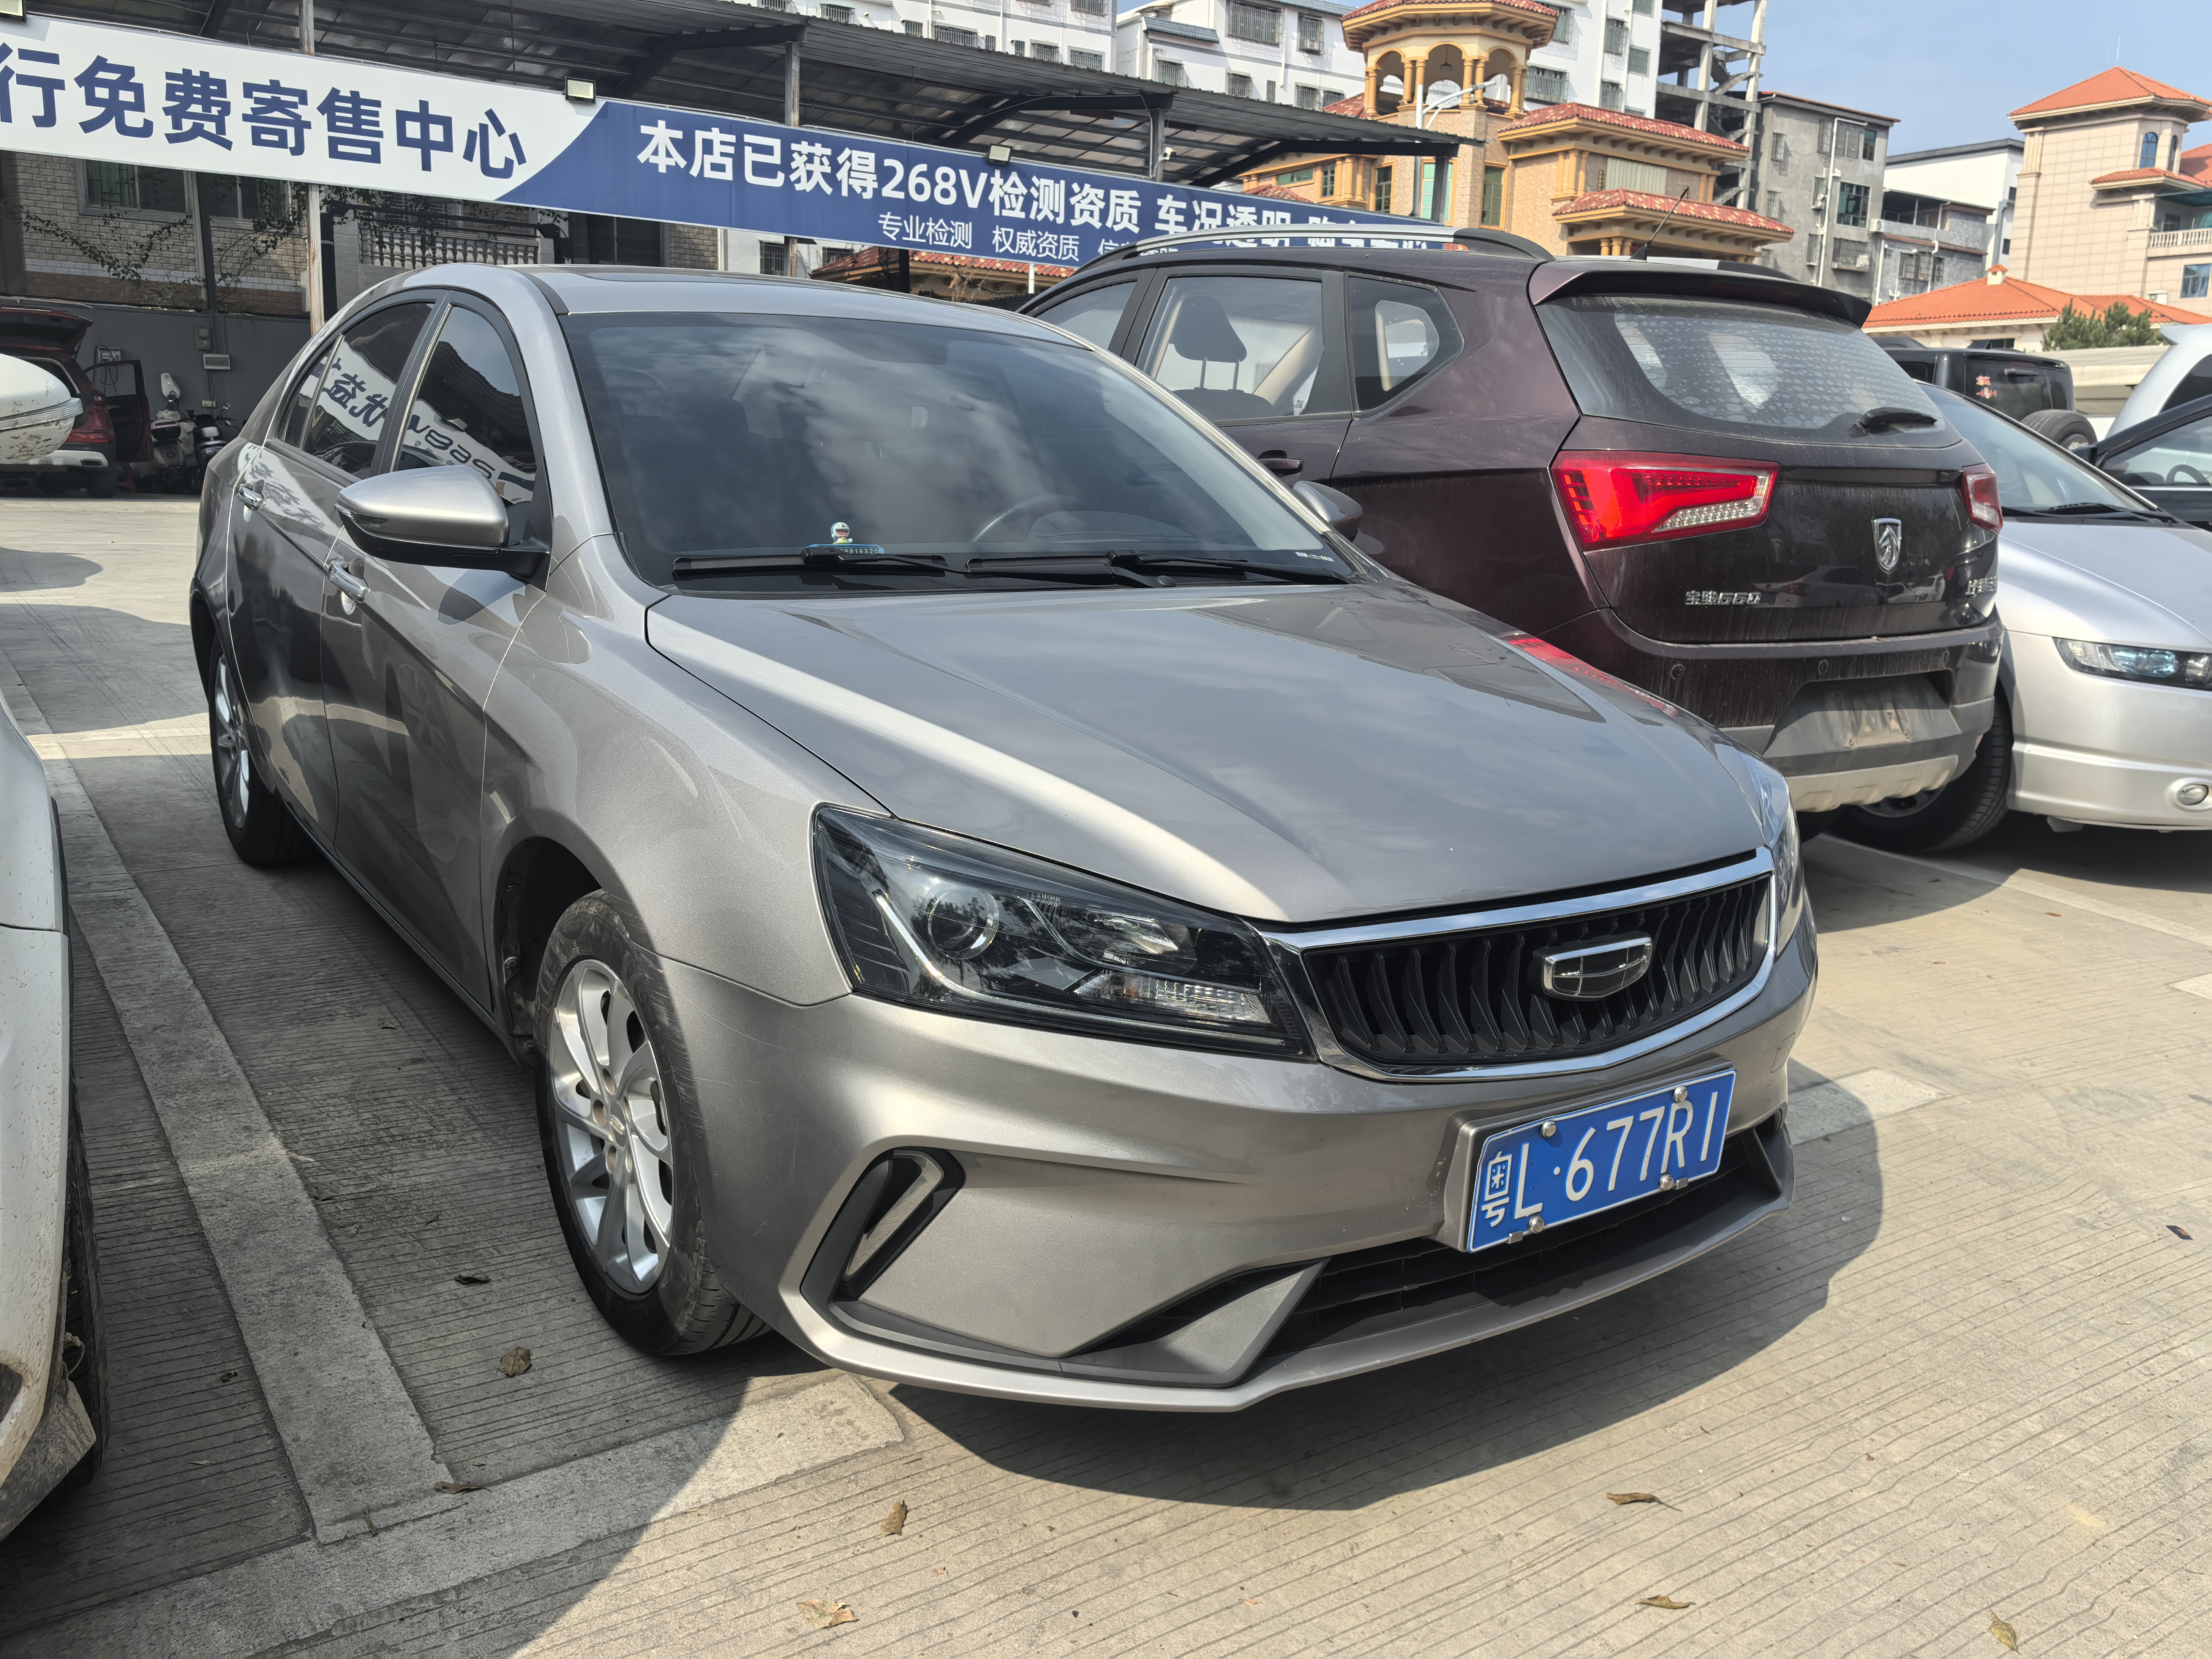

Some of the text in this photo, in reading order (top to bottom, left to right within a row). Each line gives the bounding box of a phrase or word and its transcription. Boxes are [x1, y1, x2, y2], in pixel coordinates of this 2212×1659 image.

[0, 42, 526, 179] 行免费寄售中心
[637, 119, 1141, 234] 本店已获得268V检测资质
[878, 212, 972, 249] 专业检测
[992, 225, 1080, 262] 权威资质
